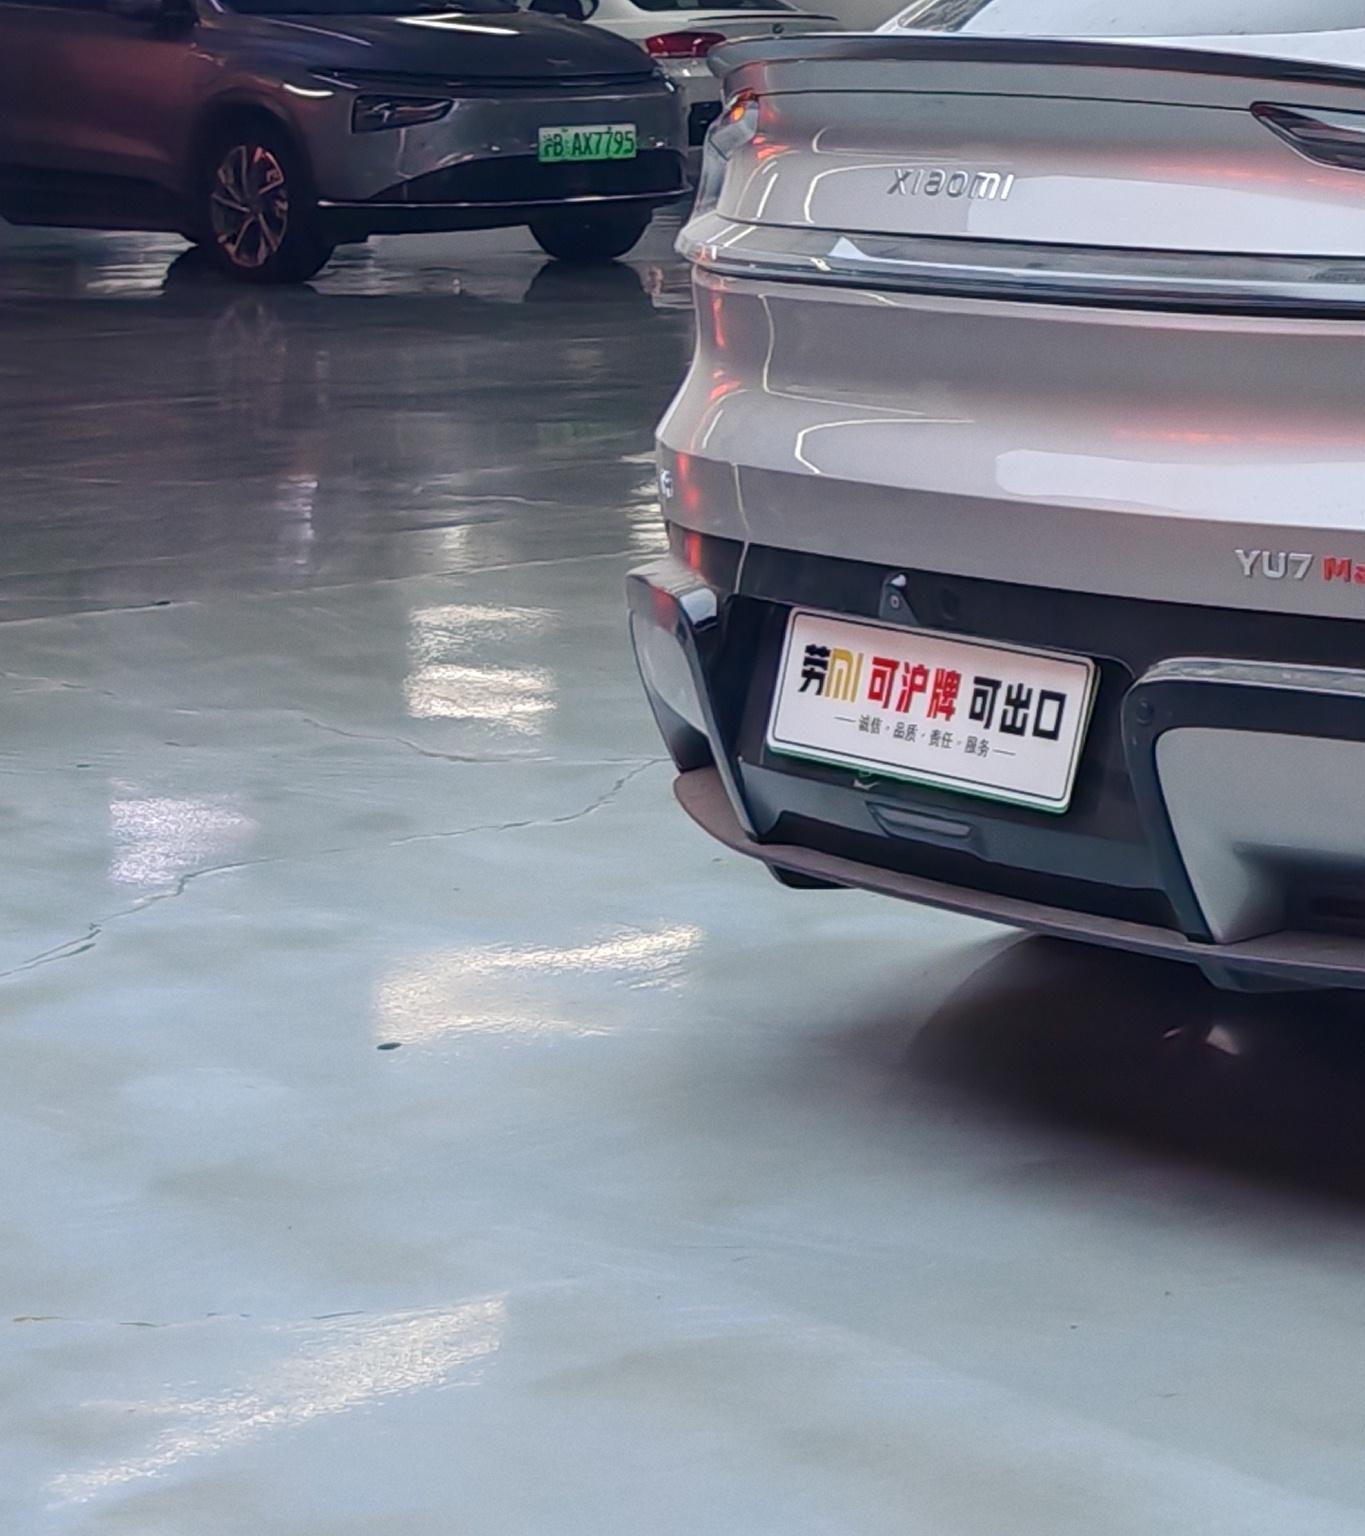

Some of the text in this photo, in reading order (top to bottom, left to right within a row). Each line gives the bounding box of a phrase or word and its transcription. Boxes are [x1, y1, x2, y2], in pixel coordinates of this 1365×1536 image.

[1234, 549, 1313, 579] YU7
[867, 656, 961, 722] 可沪牌
[968, 675, 1067, 741] 可出口
